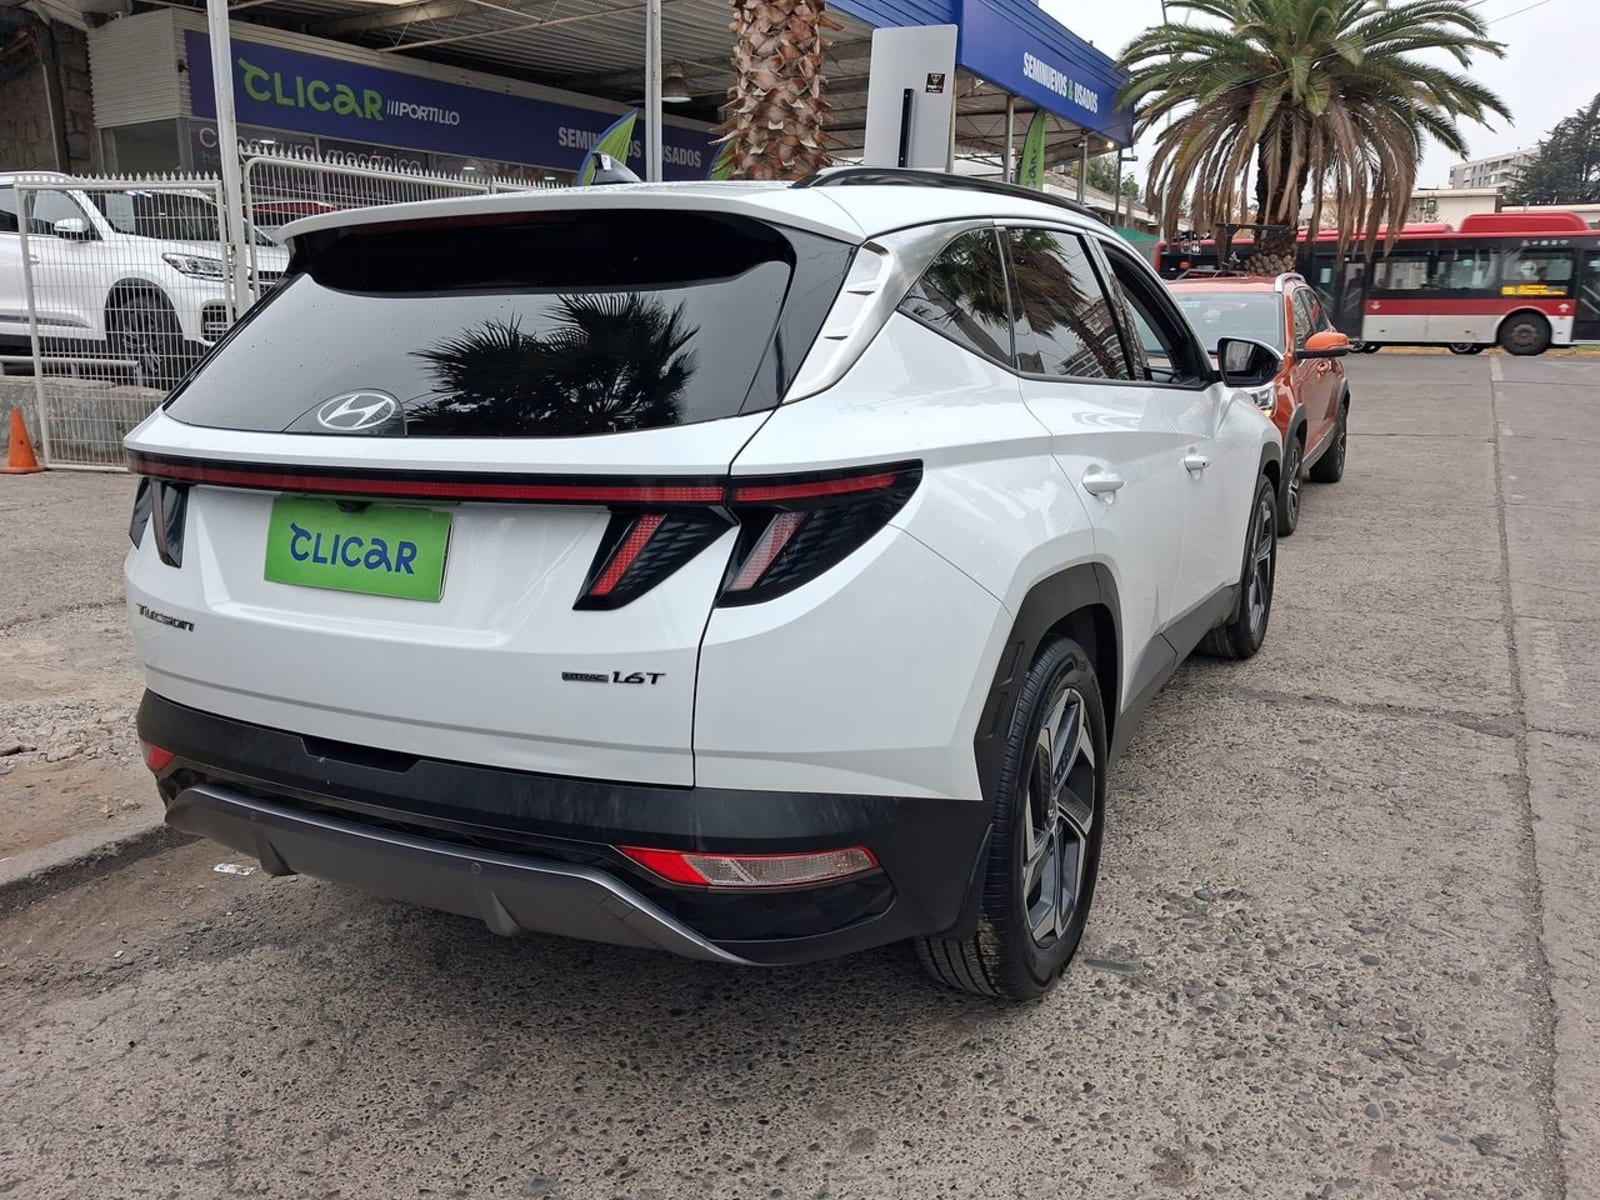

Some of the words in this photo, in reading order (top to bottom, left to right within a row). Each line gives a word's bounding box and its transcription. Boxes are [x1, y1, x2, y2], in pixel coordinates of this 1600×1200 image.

[1023, 52, 1068, 97] SEMINUEVOS
[1074, 82, 1098, 113] USADOS
[136, 602, 195, 633] Tucson
